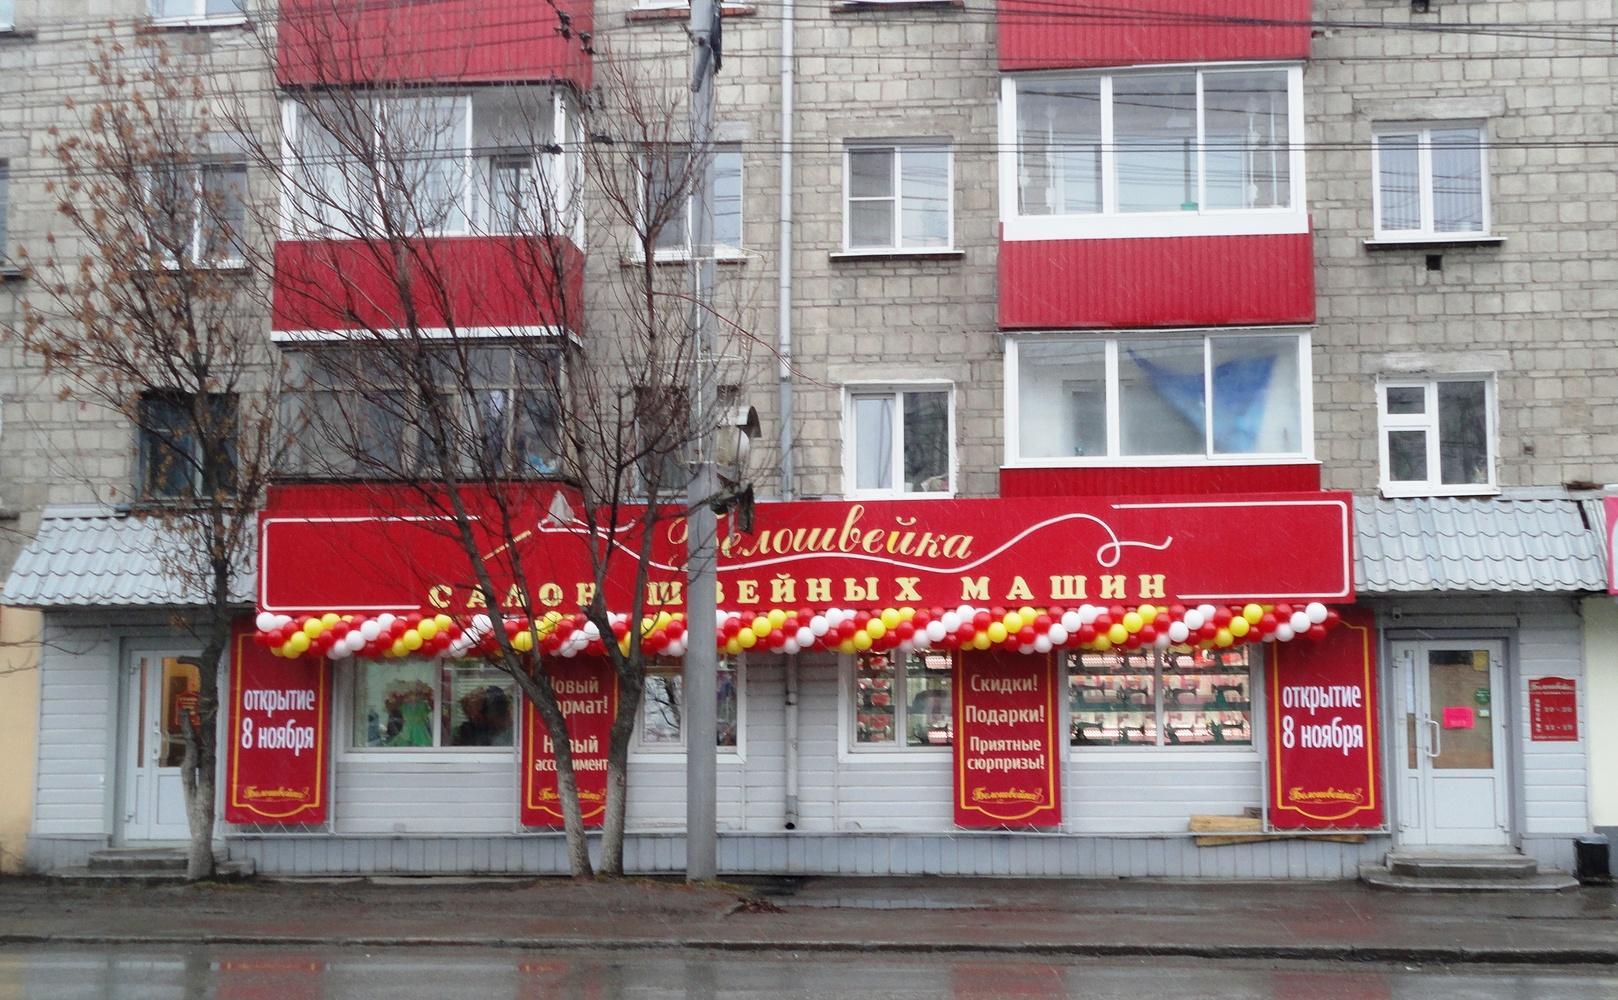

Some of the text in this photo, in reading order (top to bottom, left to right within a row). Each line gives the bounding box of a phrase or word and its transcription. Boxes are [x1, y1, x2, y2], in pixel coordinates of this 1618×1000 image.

[428, 582, 597, 608] САЛОН
[960, 574, 1167, 601] МАШИН
[971, 674, 1038, 694] Скидки!
[243, 689, 316, 718] открытие
[557, 696, 609, 719] рмат!
[1282, 685, 1362, 715] открытие
[965, 705, 1045, 727] Подарки!
[241, 717, 315, 757] 8 ноября
[969, 736, 1042, 755] Приятные
[1282, 715, 1364, 756] 8 ноября
[967, 755, 1045, 773] сюрпризы!
